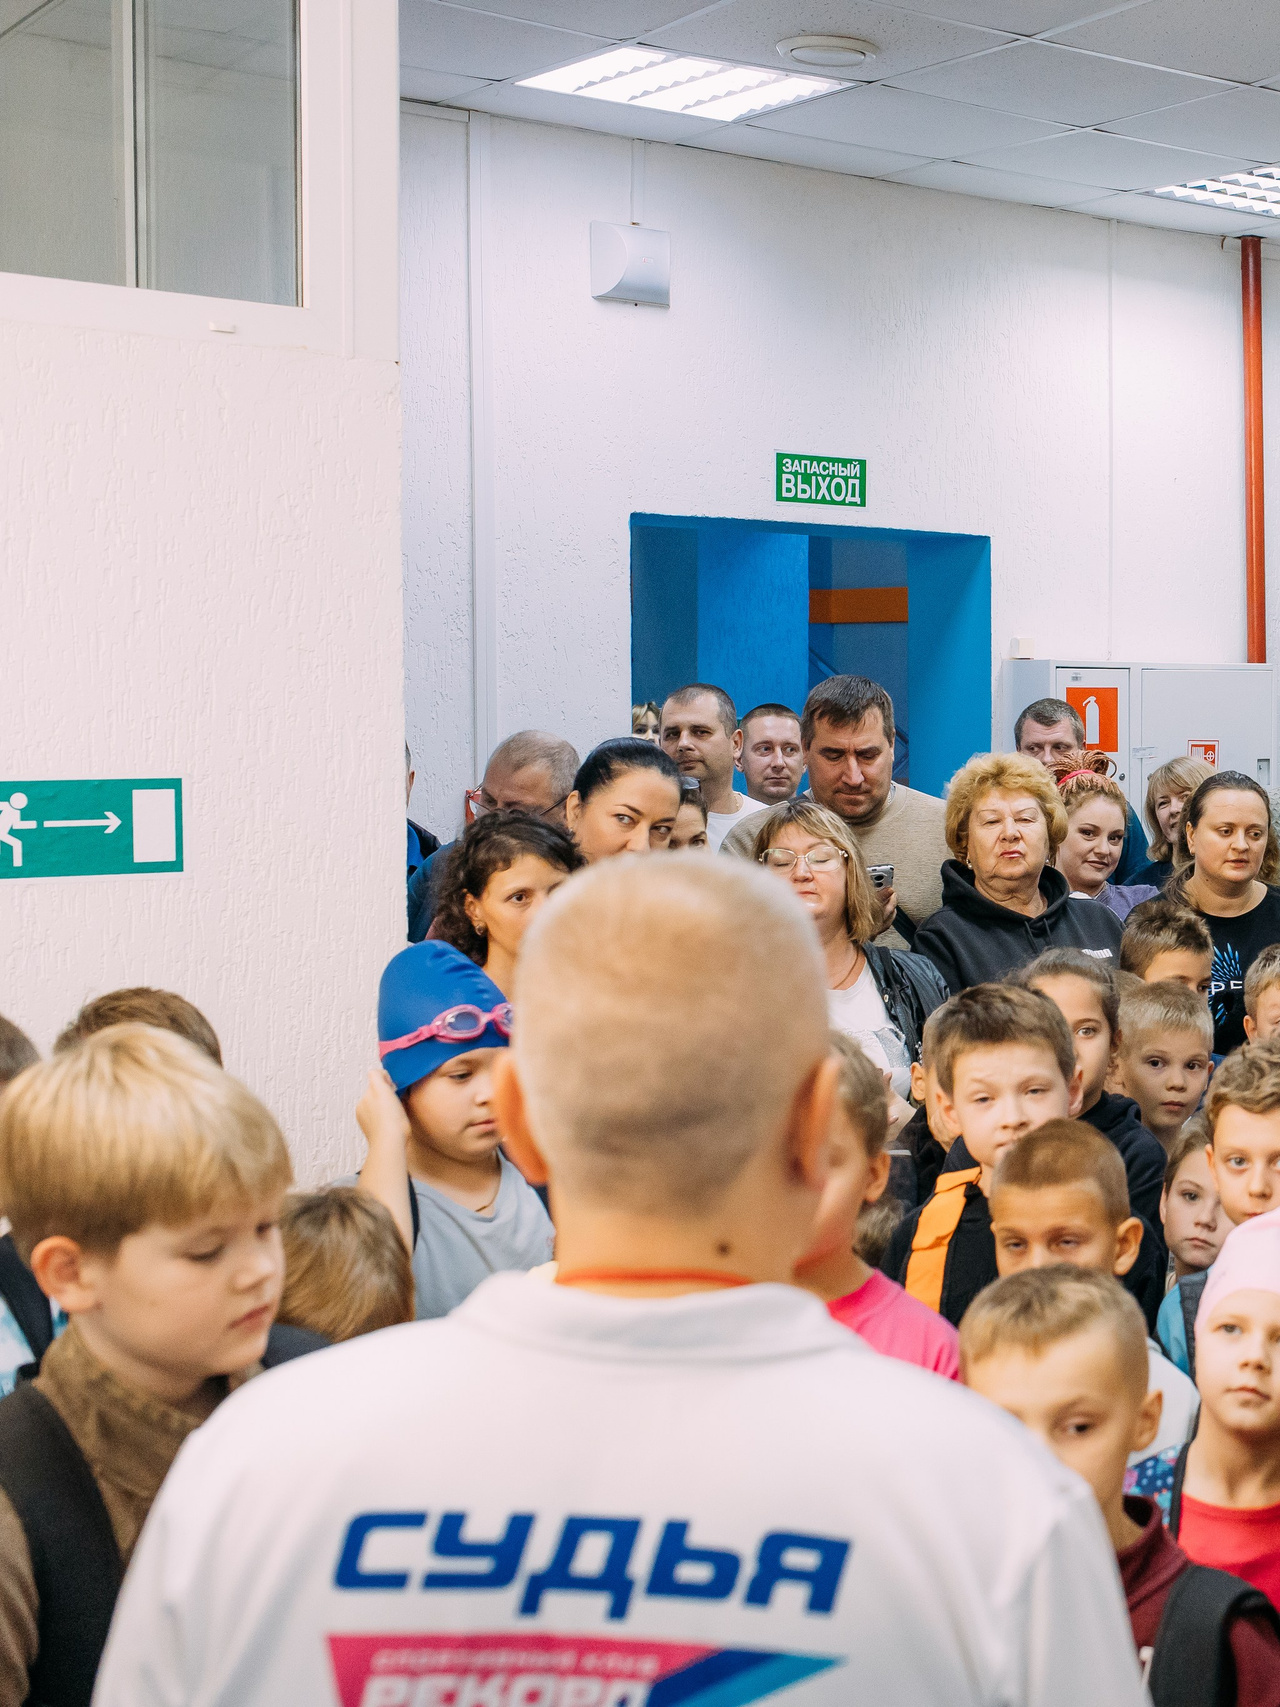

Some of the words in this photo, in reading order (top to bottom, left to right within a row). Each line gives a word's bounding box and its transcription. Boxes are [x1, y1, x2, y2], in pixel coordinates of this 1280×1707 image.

[782, 458, 860, 477] ЗАПАСНЫЙ
[782, 473, 861, 504] ВЫХОД
[332, 1511, 852, 1621] СУДЬЯ
